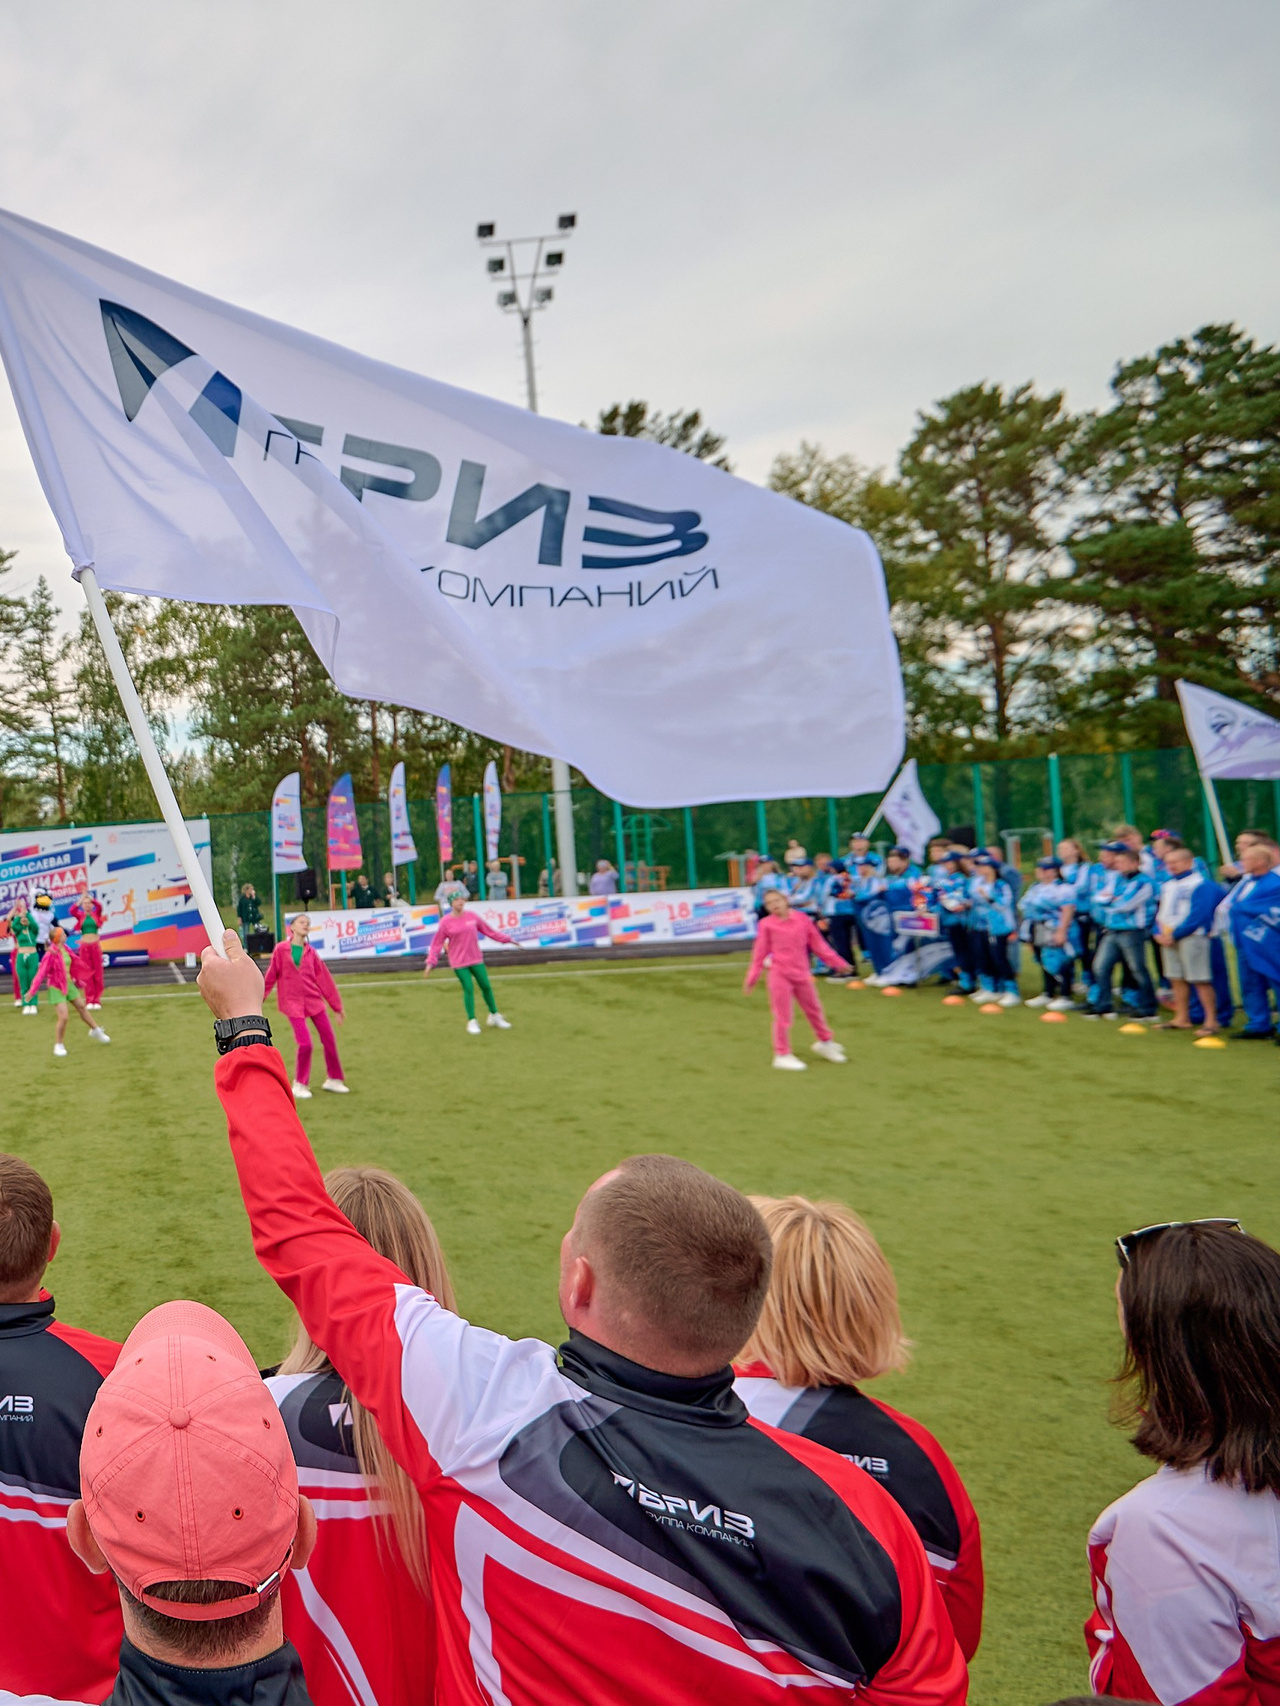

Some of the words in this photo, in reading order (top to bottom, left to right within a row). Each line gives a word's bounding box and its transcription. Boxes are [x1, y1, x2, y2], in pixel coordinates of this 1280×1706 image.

[270, 413, 710, 570] РИЗ
[420, 556, 718, 607] ОМПАНИЙ
[0, 853, 70, 878] ОТРАСЛЕВАЯ
[497, 911, 519, 929] 18
[667, 902, 690, 921] 18
[336, 920, 356, 938] 18
[341, 928, 401, 946] СПАРТАКИАДА
[102, 954, 110, 967] 3
[638, 1482, 755, 1540] БРИЗ
[645, 1510, 685, 1530] РУППА
